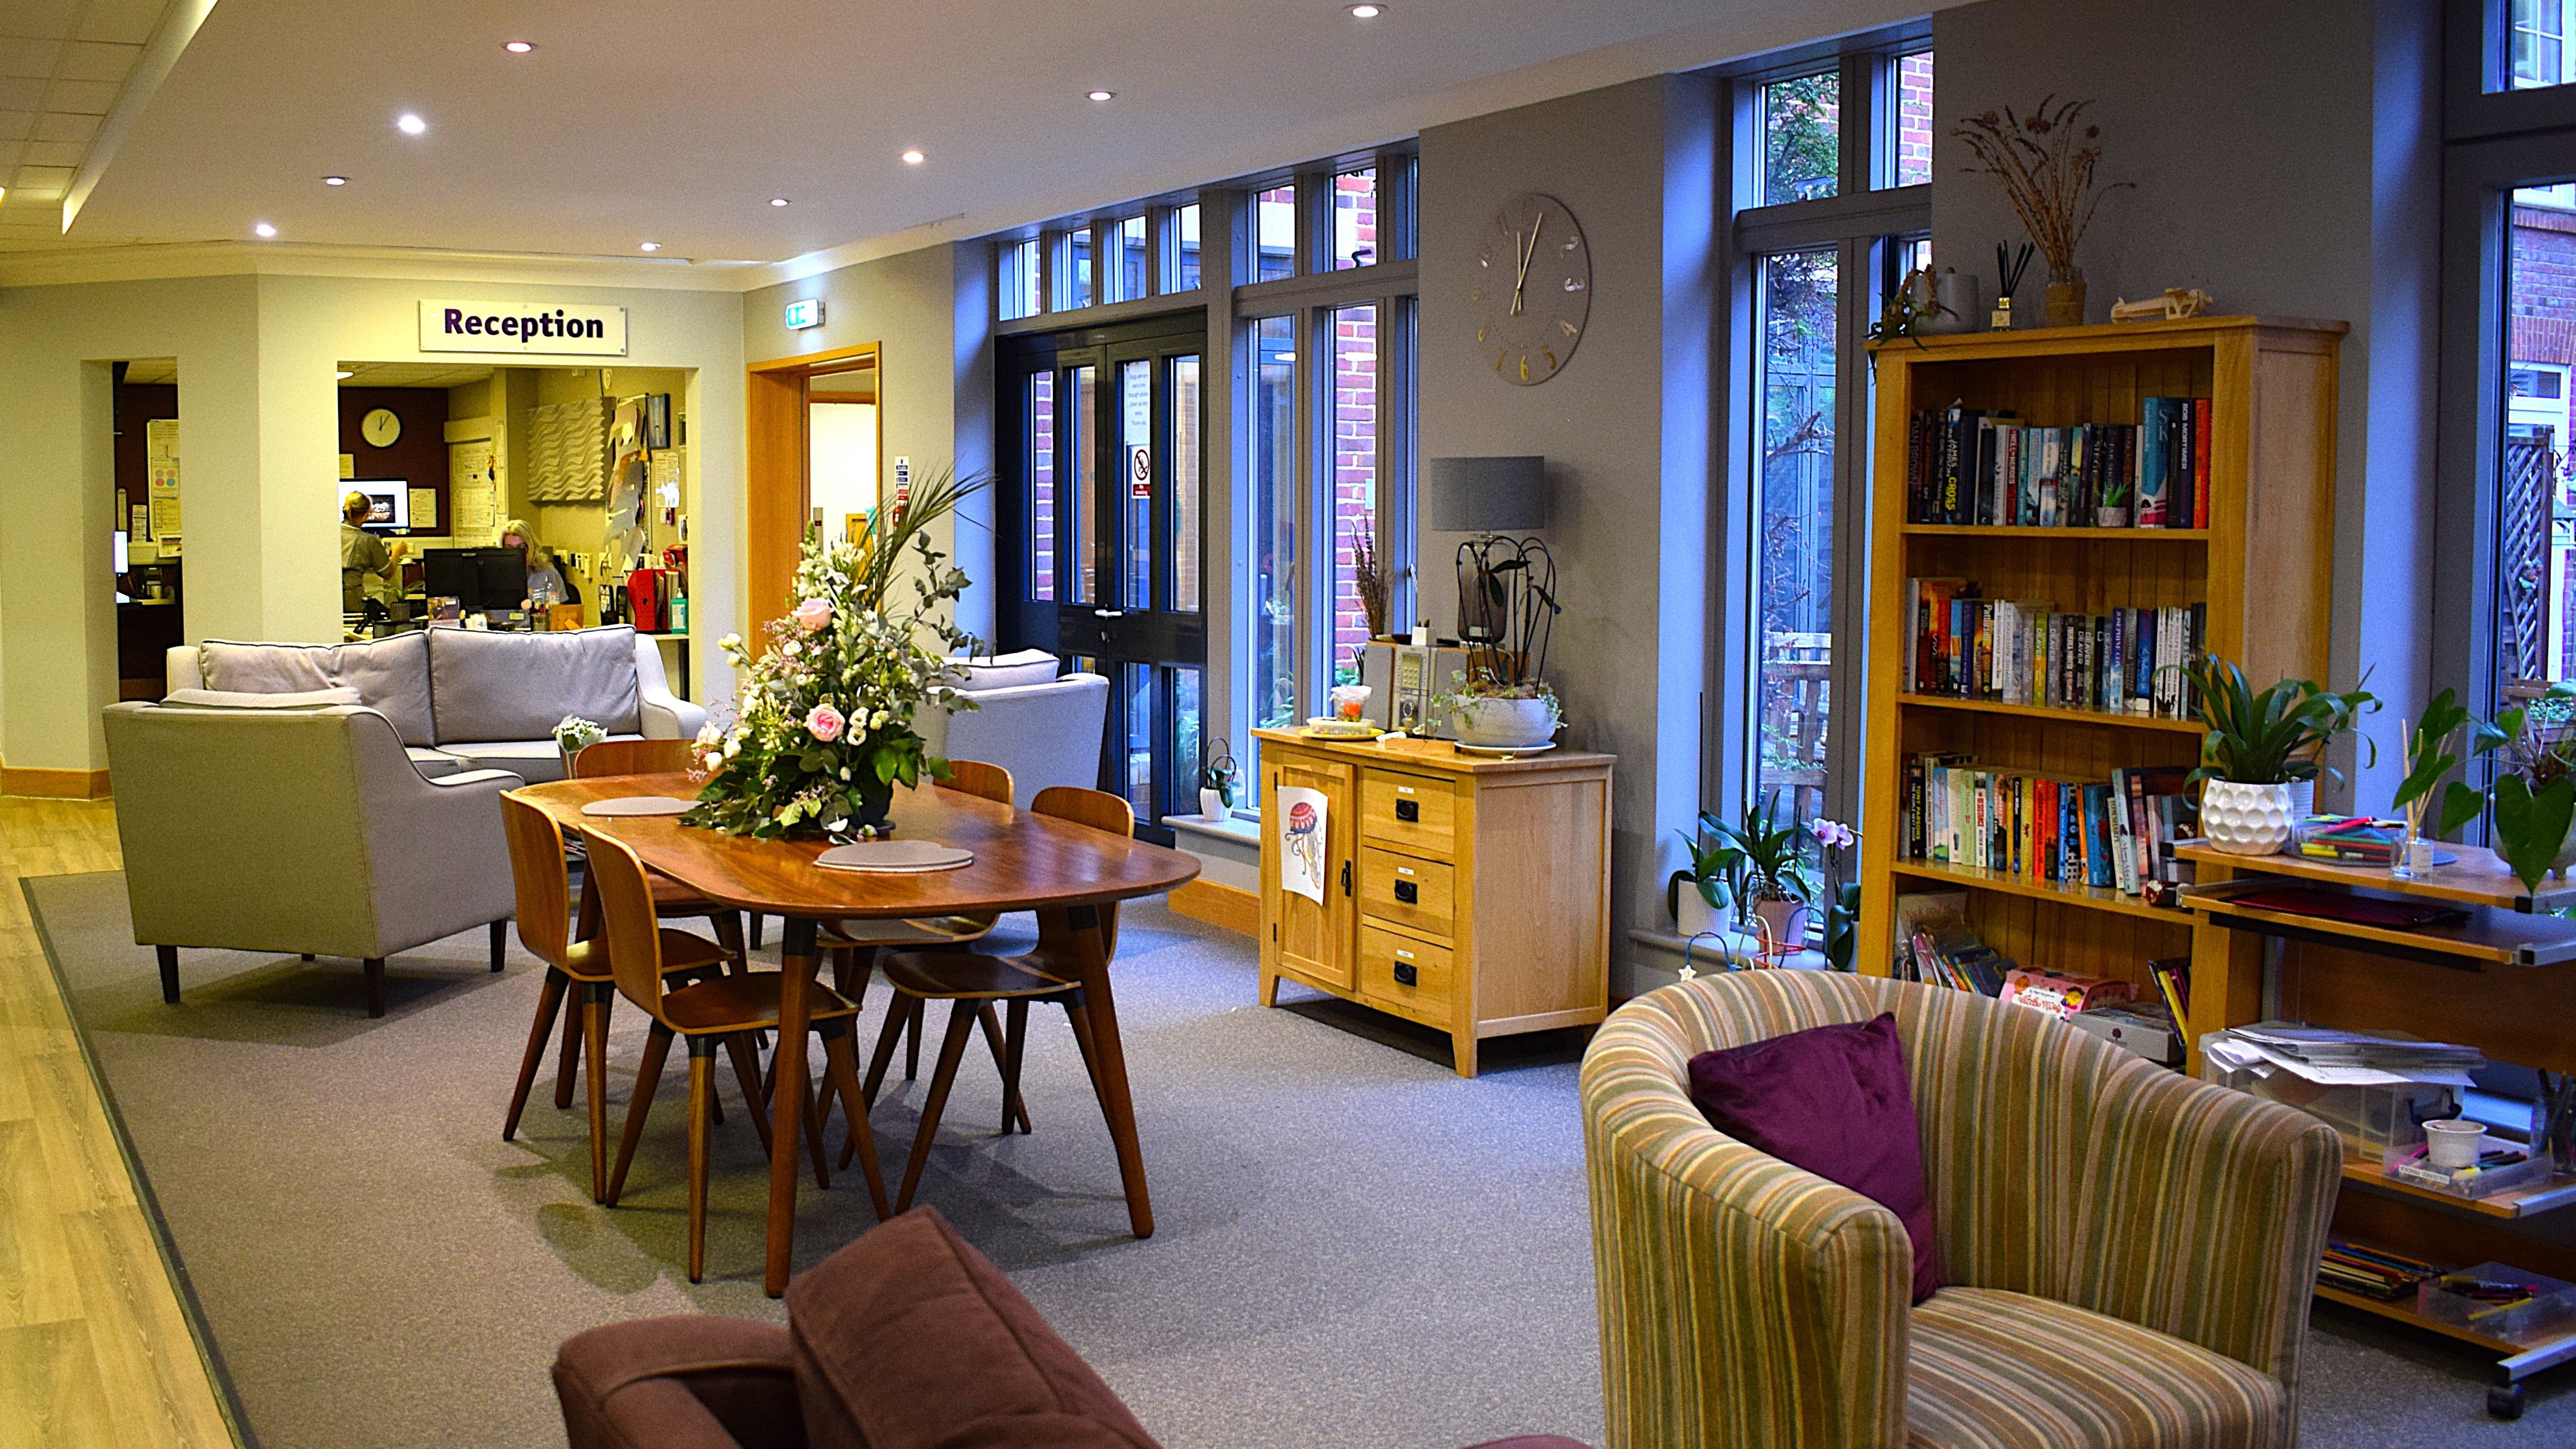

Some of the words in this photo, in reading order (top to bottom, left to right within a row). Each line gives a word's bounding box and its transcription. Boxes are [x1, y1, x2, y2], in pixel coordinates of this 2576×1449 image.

[444, 308, 604, 343] Reception
[1911, 420, 1920, 443] DAN
[1909, 445, 1919, 485] BROWN
[1938, 455, 1944, 465] ON
[1947, 476, 1957, 511] CROSS
[1982, 604, 1993, 643] Patterson
[2035, 627, 2043, 661] DEAVER
[2112, 816, 2120, 843] SHARPE
